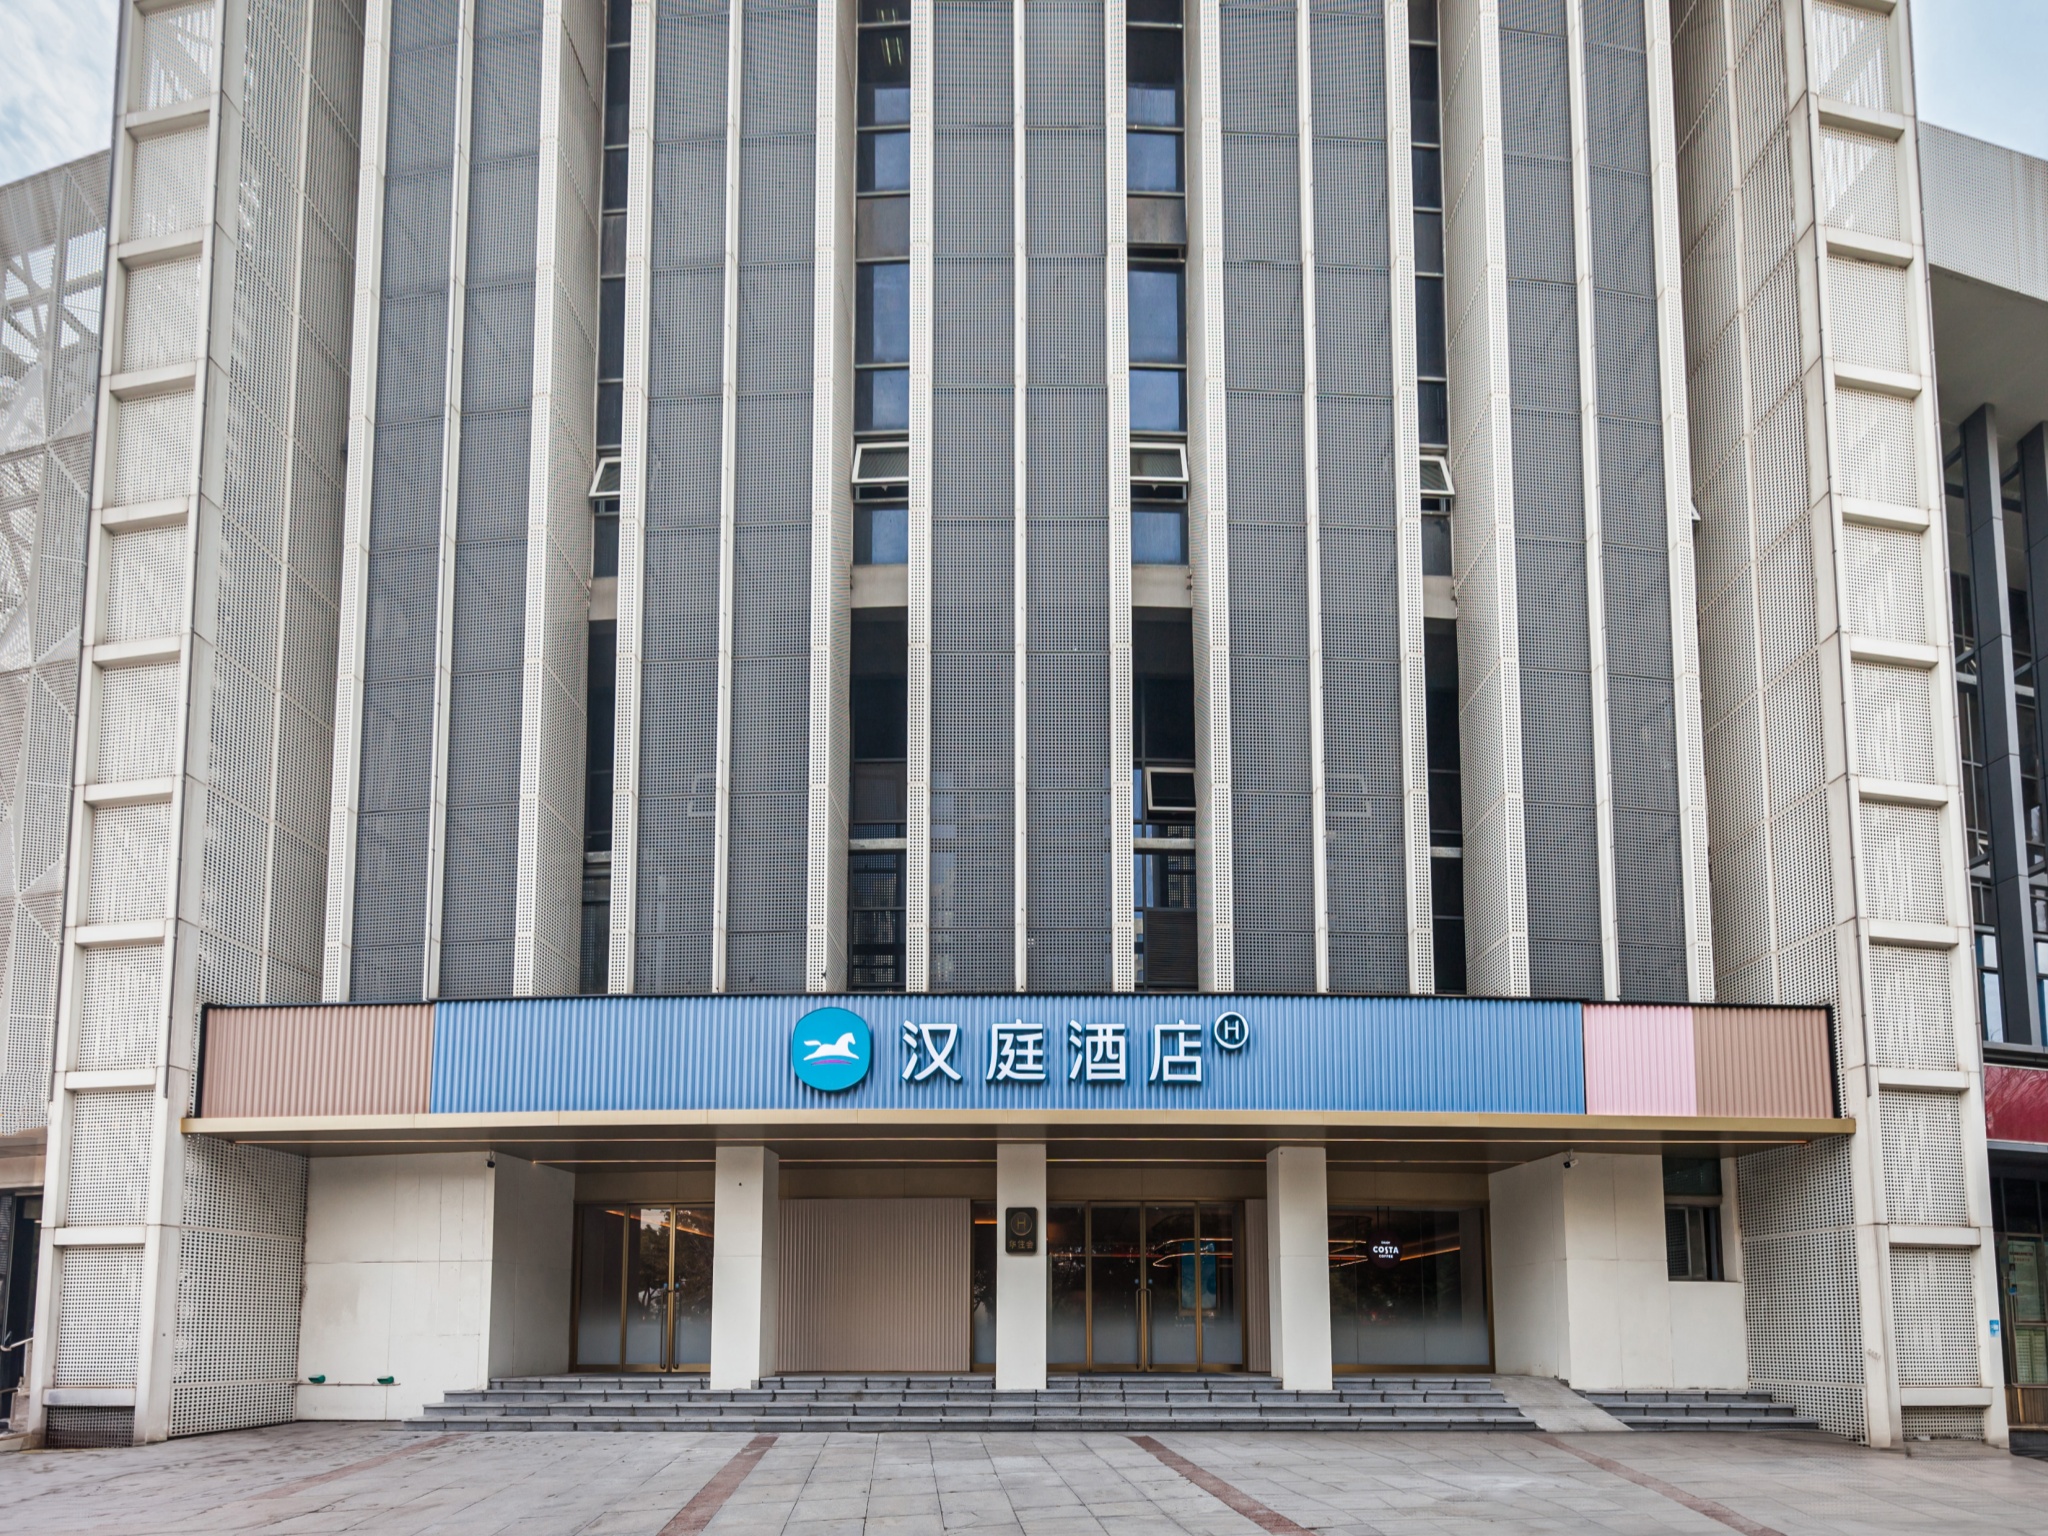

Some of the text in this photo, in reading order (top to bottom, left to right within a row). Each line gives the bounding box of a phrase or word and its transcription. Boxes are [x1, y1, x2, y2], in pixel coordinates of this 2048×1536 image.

[902, 1019, 1203, 1083] 汉庭酒店
[1372, 1245, 1399, 1254] COSTA
